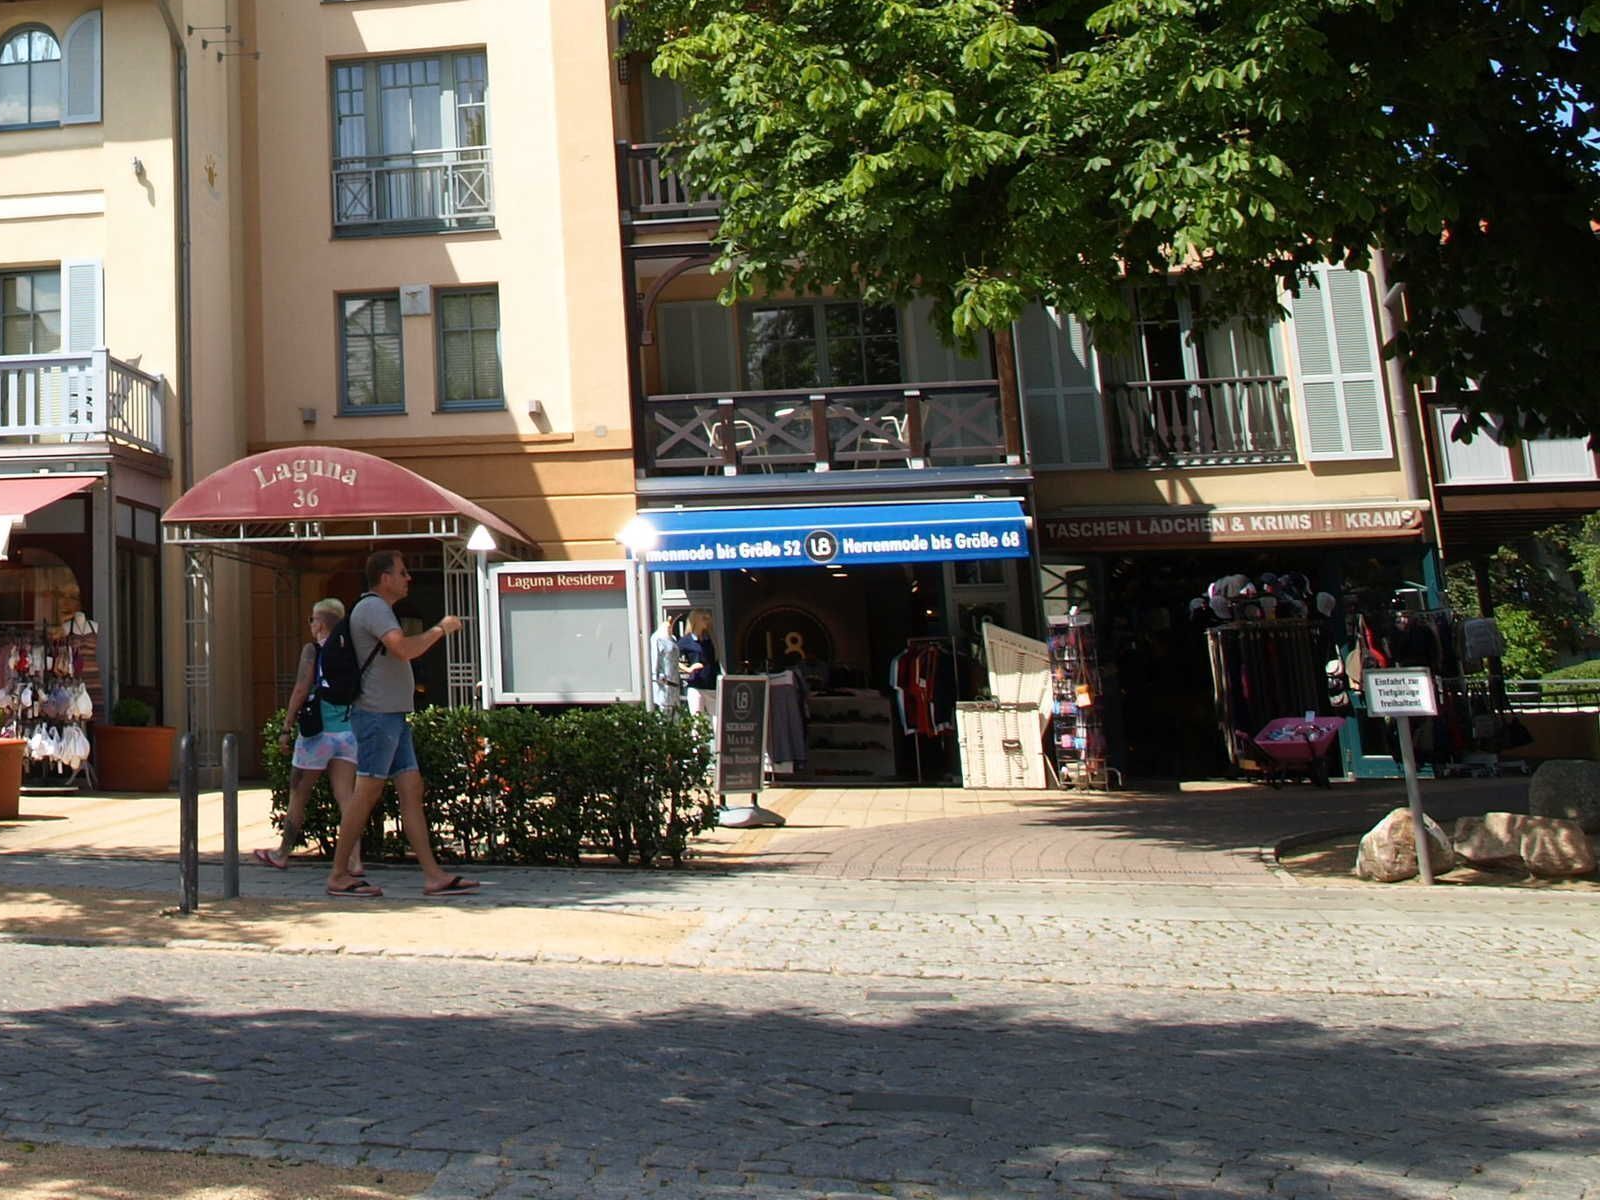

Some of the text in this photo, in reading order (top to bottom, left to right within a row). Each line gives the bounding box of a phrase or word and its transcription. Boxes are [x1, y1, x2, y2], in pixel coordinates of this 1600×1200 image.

[252, 459, 357, 489] Laguna
[293, 488, 320, 508] 36
[1045, 520, 1131, 538] TASCHEN
[1137, 514, 1226, 534] LÄDCHEN
[1231, 516, 1245, 532] &
[1250, 514, 1312, 531] KRIMS
[1345, 510, 1414, 529] KRAMS
[716, 543, 737, 560] bis
[783, 540, 801, 556] 52
[842, 531, 1020, 554] Herrenmode bis Größe 68
[507, 574, 615, 590] Laguna Residenz
